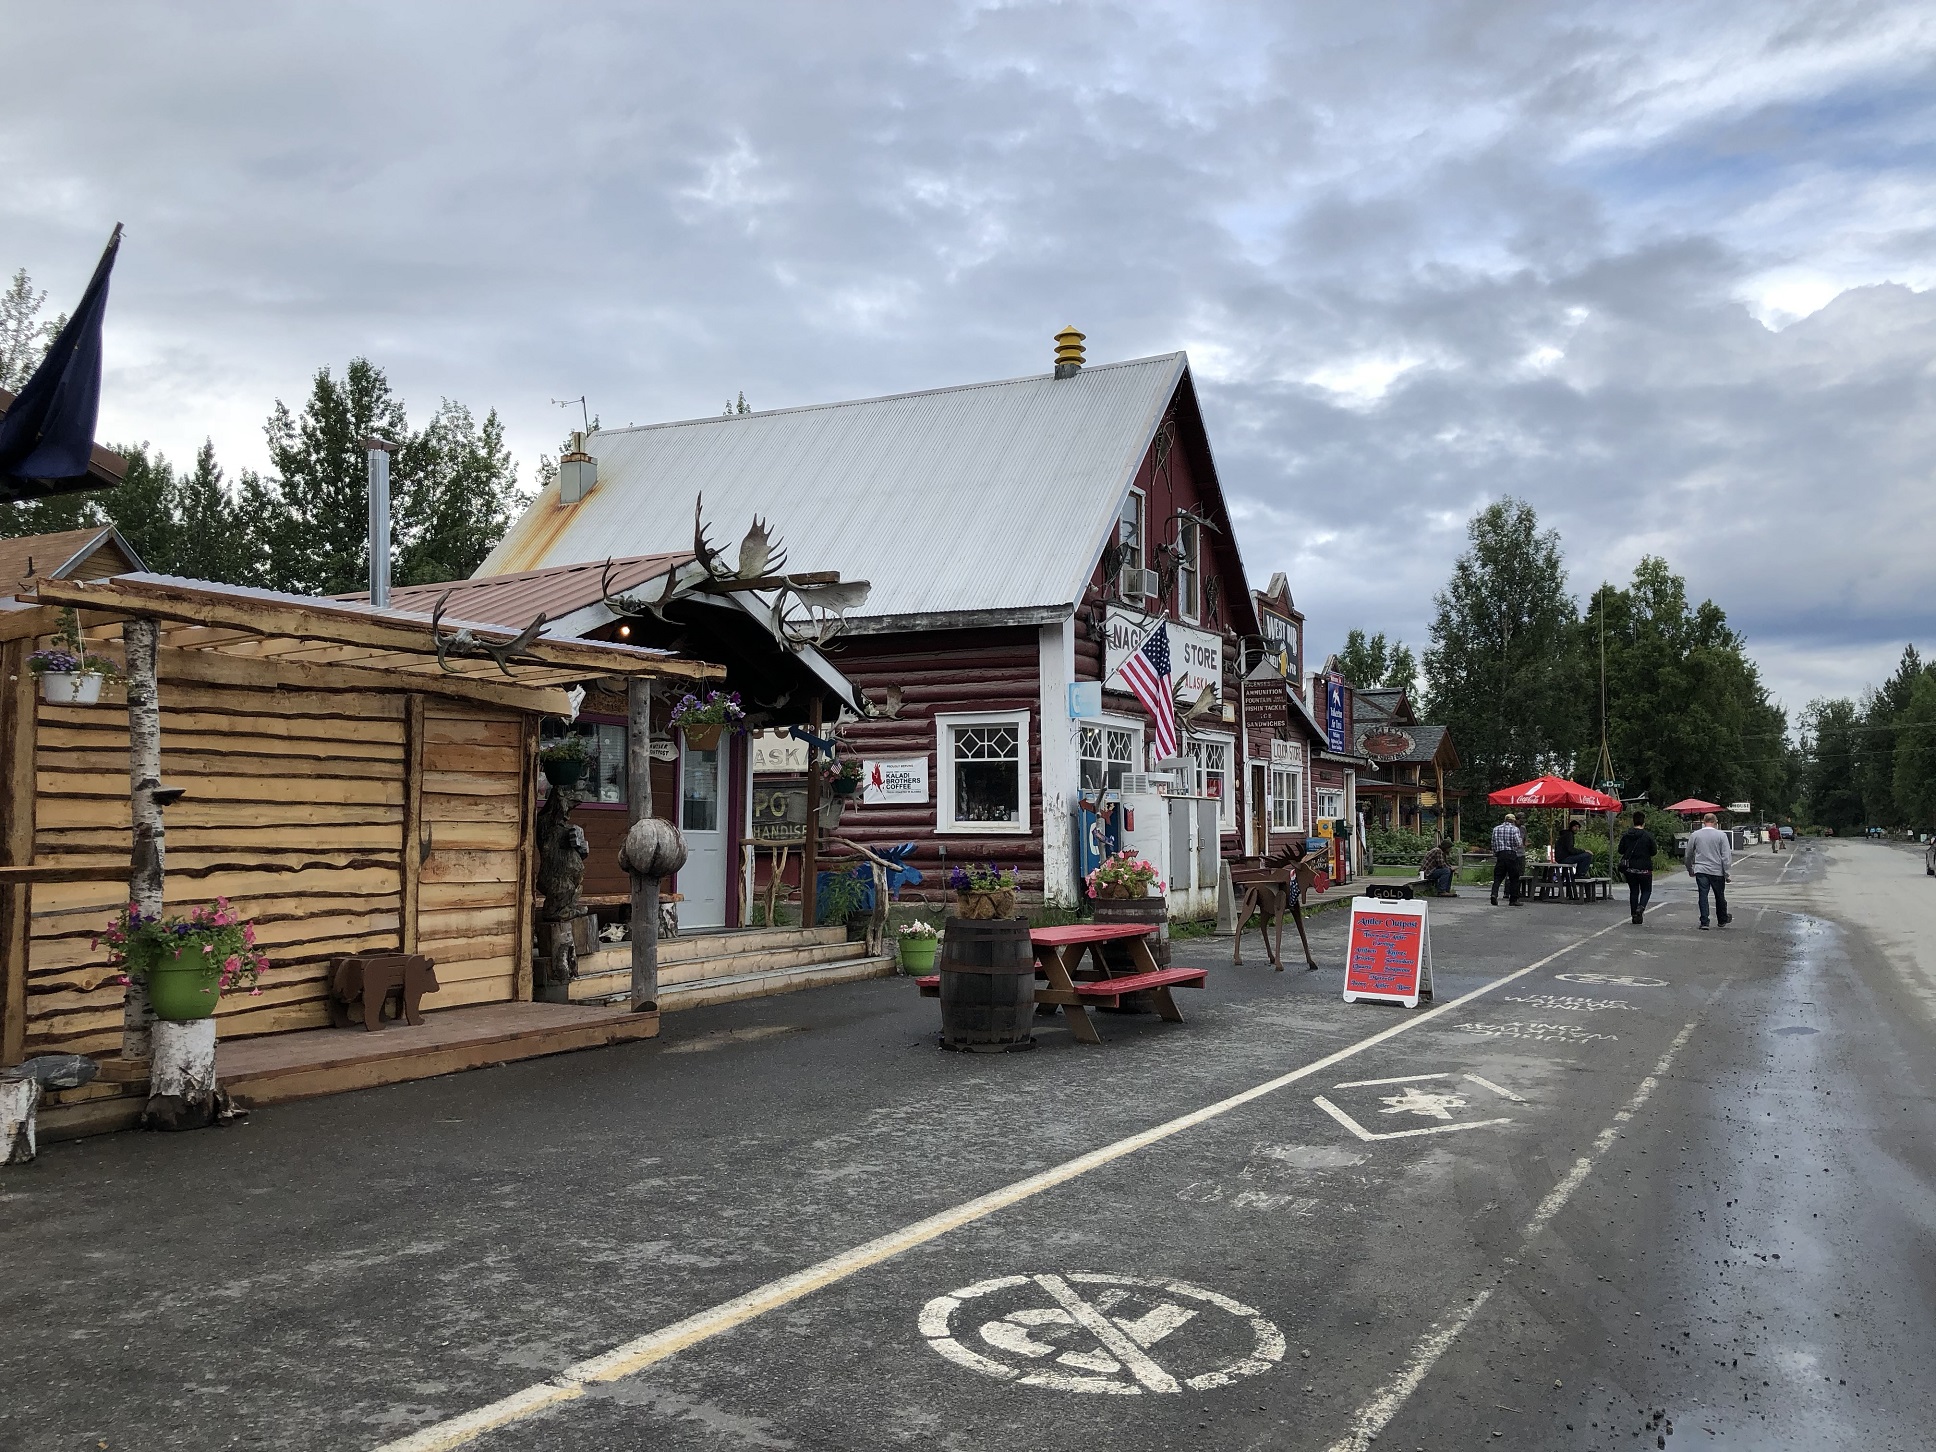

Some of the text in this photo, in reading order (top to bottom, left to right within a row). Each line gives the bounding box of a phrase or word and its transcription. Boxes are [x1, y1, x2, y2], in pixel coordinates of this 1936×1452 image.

[1266, 615, 1286, 642] WEST
[1184, 642, 1218, 671] STORE
[1246, 688, 1283, 696] AMMUNITION
[1246, 720, 1285, 728] SANDWICHES
[1289, 745, 1302, 762] STORE
[1516, 795, 1539, 804] Coca-Cola
[1373, 888, 1404, 899] GOLD
[1358, 917, 1418, 930] Antler Outpost
[1532, 1003, 1603, 1011] ONLY
